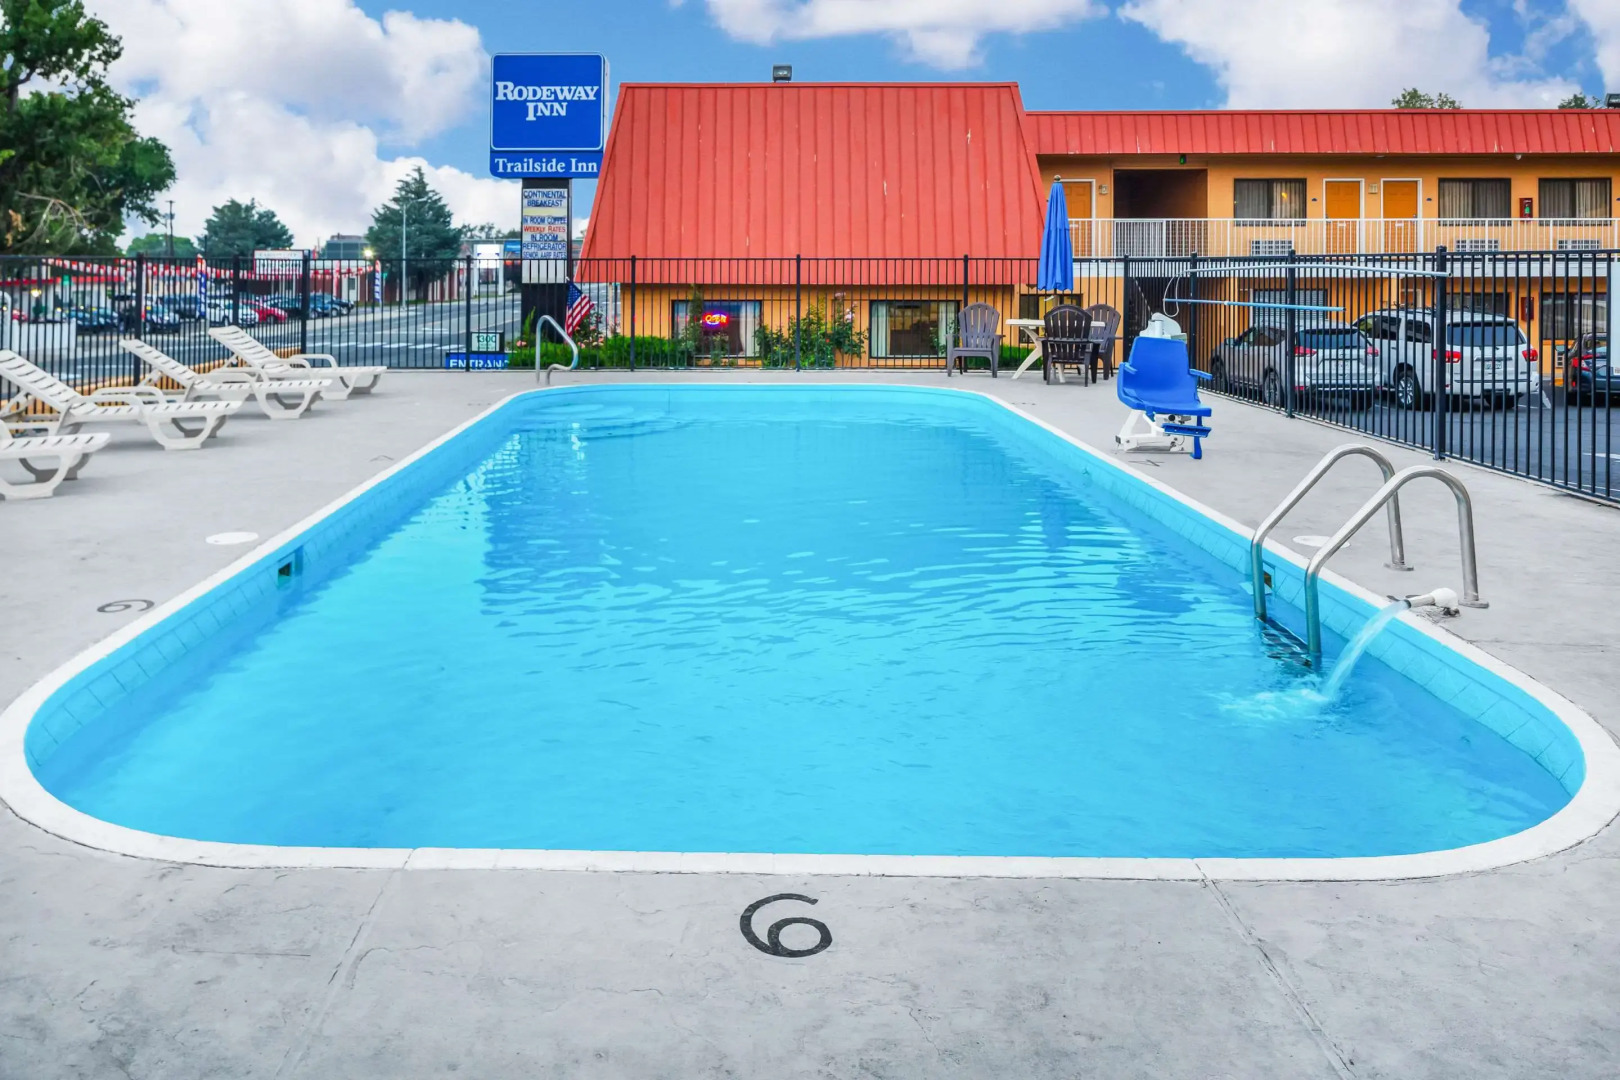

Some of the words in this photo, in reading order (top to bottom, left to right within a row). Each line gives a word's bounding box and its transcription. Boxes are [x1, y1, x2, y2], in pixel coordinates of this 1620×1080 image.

[495, 81, 599, 100] RODEWAY
[526, 102, 568, 121] INN
[495, 158, 566, 173] Trailside
[570, 158, 598, 173] Inn
[523, 190, 566, 199] CONTINENTAL
[527, 199, 563, 207] BREAKFAST
[530, 216, 545, 224] ROOM
[739, 892, 833, 958] 6
